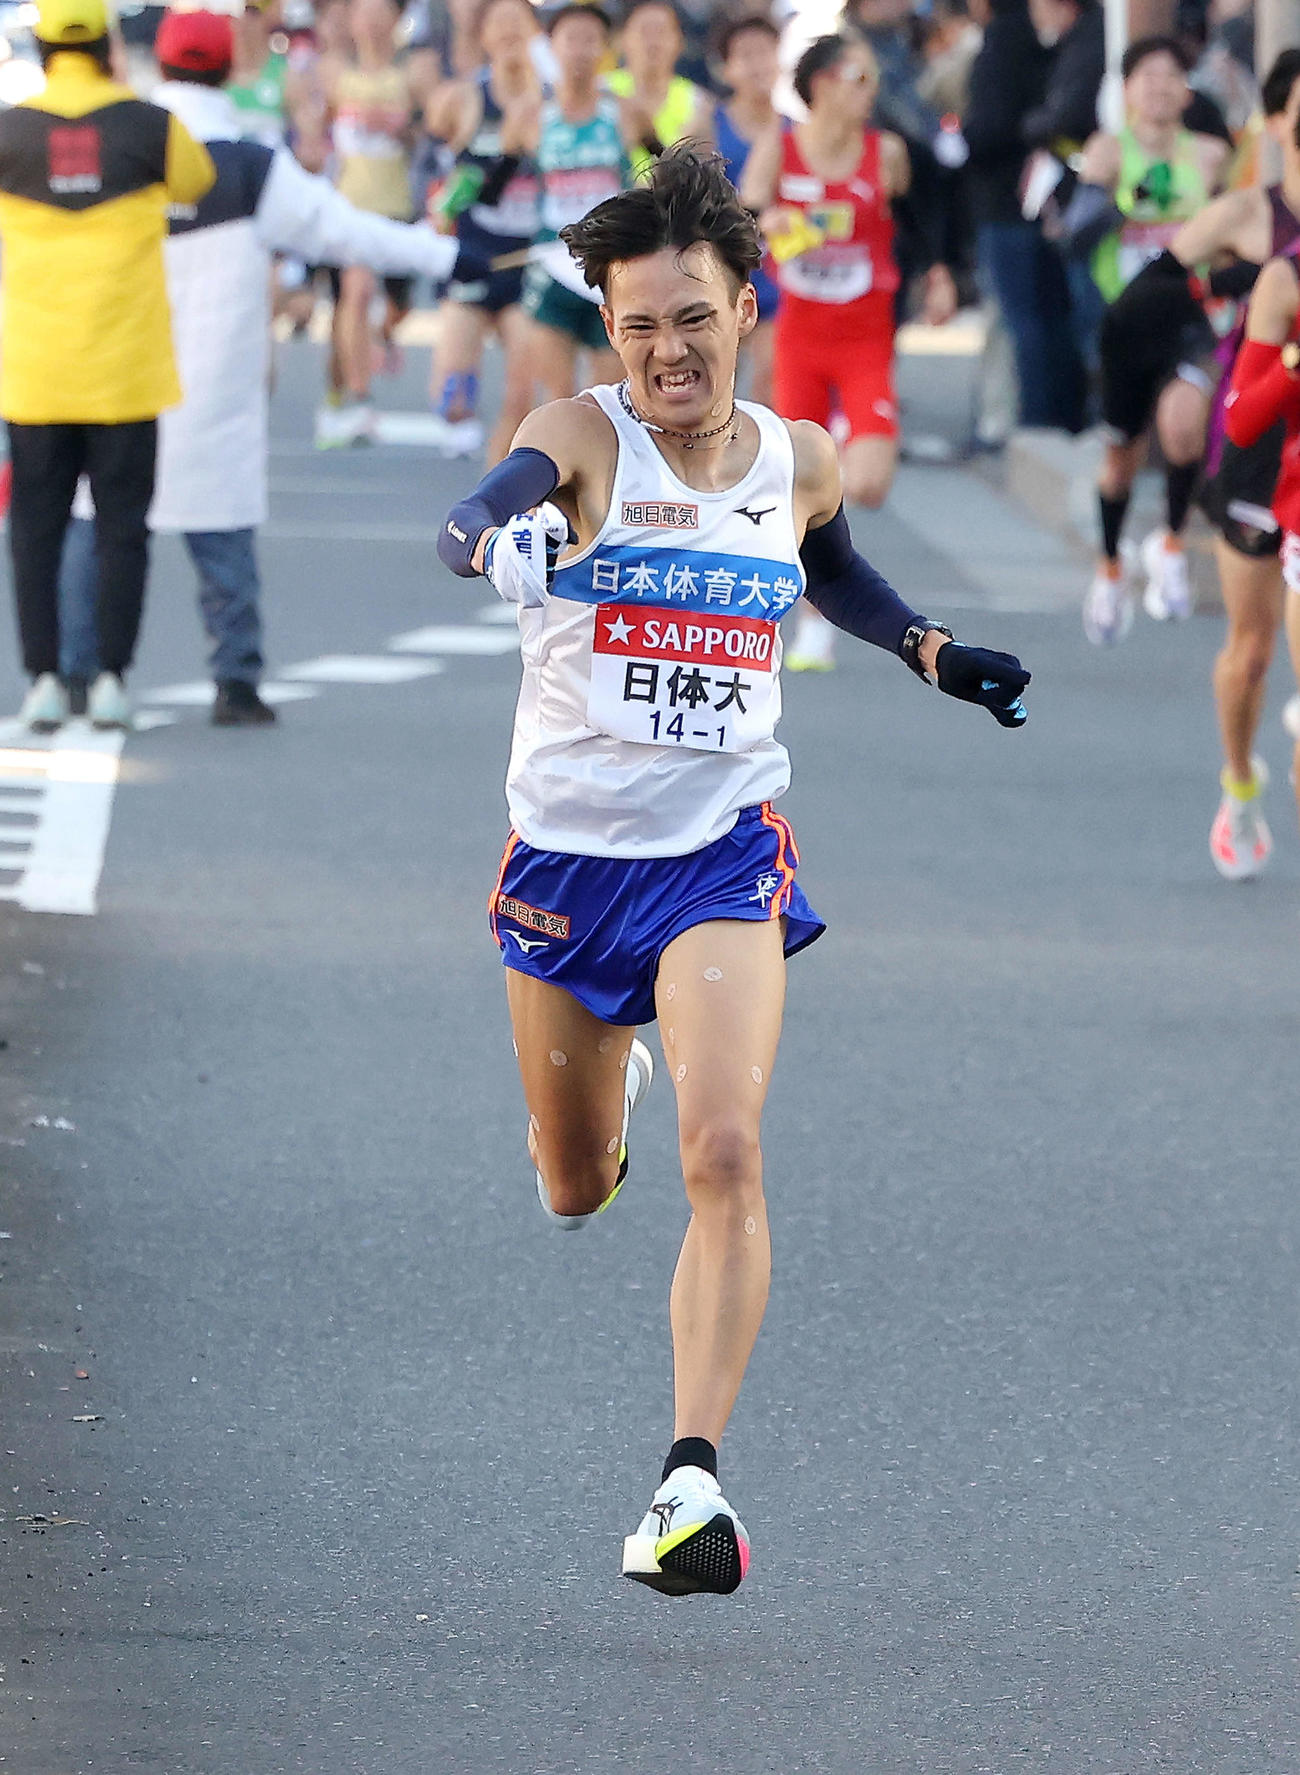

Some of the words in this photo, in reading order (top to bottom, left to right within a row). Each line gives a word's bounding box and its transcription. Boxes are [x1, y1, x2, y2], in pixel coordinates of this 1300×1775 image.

[624, 504, 696, 527] 旭日電気
[591, 558, 799, 610] 日本体育大学
[642, 619, 771, 662] SAPPORO
[622, 661, 752, 715] 日体大
[499, 898, 568, 937] 旭日電気
